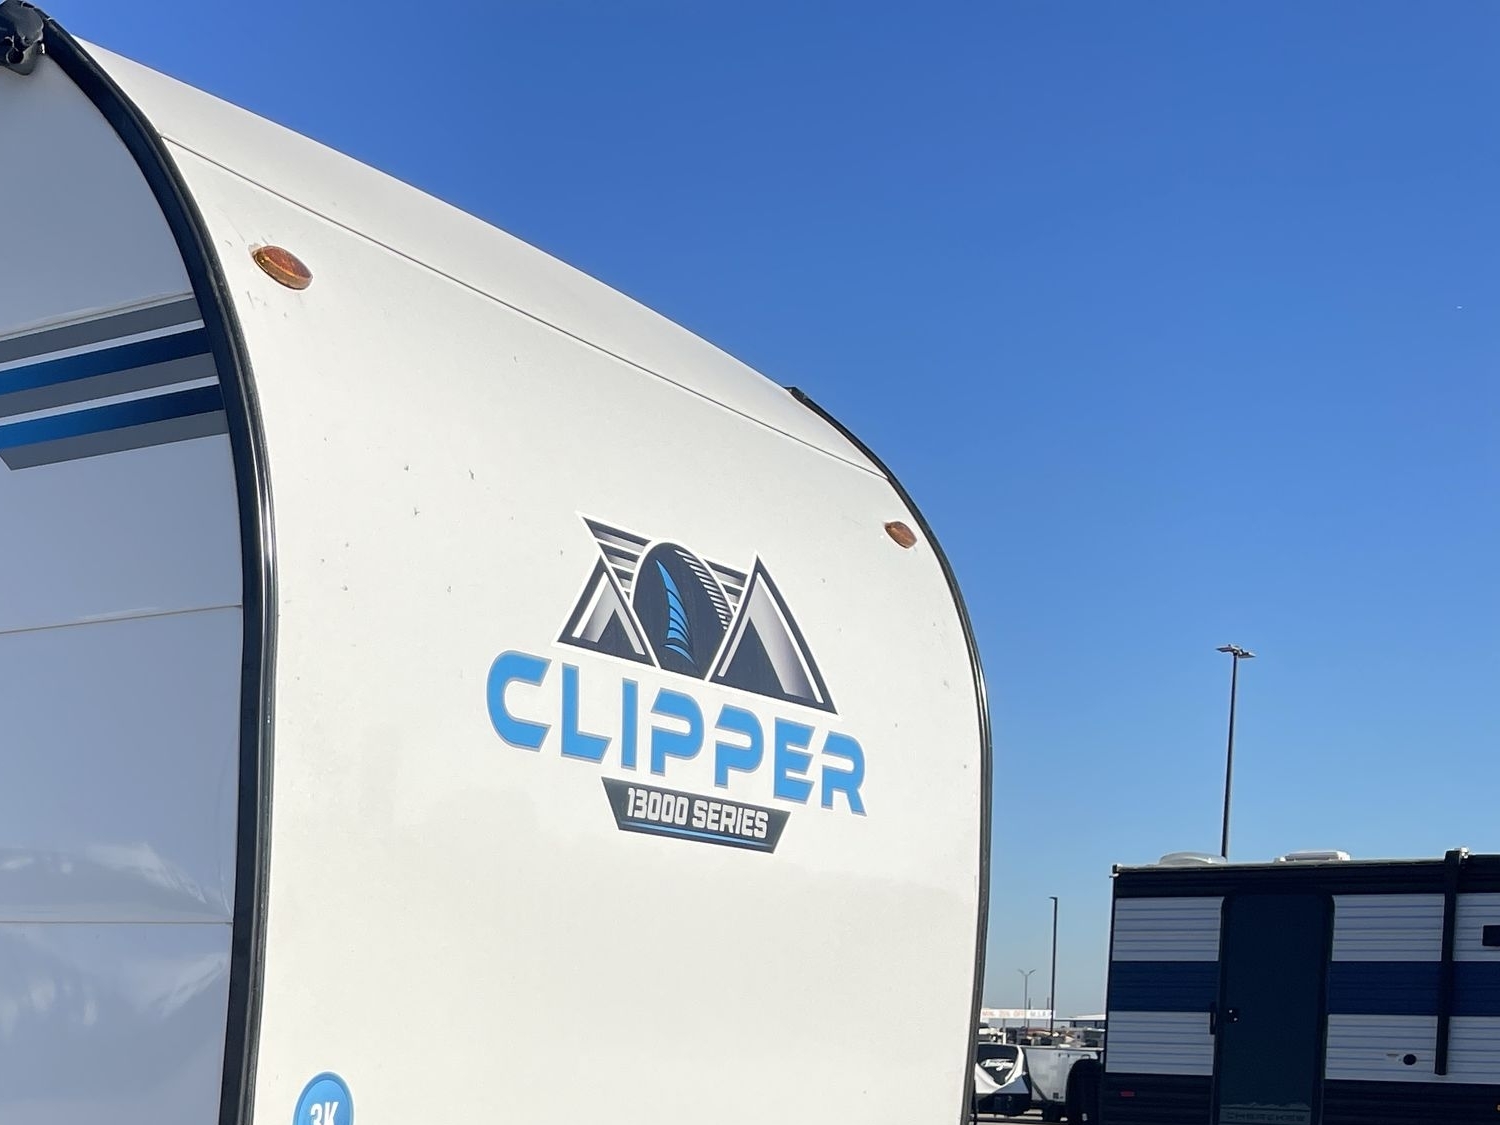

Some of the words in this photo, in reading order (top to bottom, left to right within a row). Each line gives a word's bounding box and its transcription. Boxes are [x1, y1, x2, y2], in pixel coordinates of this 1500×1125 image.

[486, 649, 868, 817] CLIPPER
[626, 787, 688, 827] 13000
[692, 799, 769, 840] SERIES
